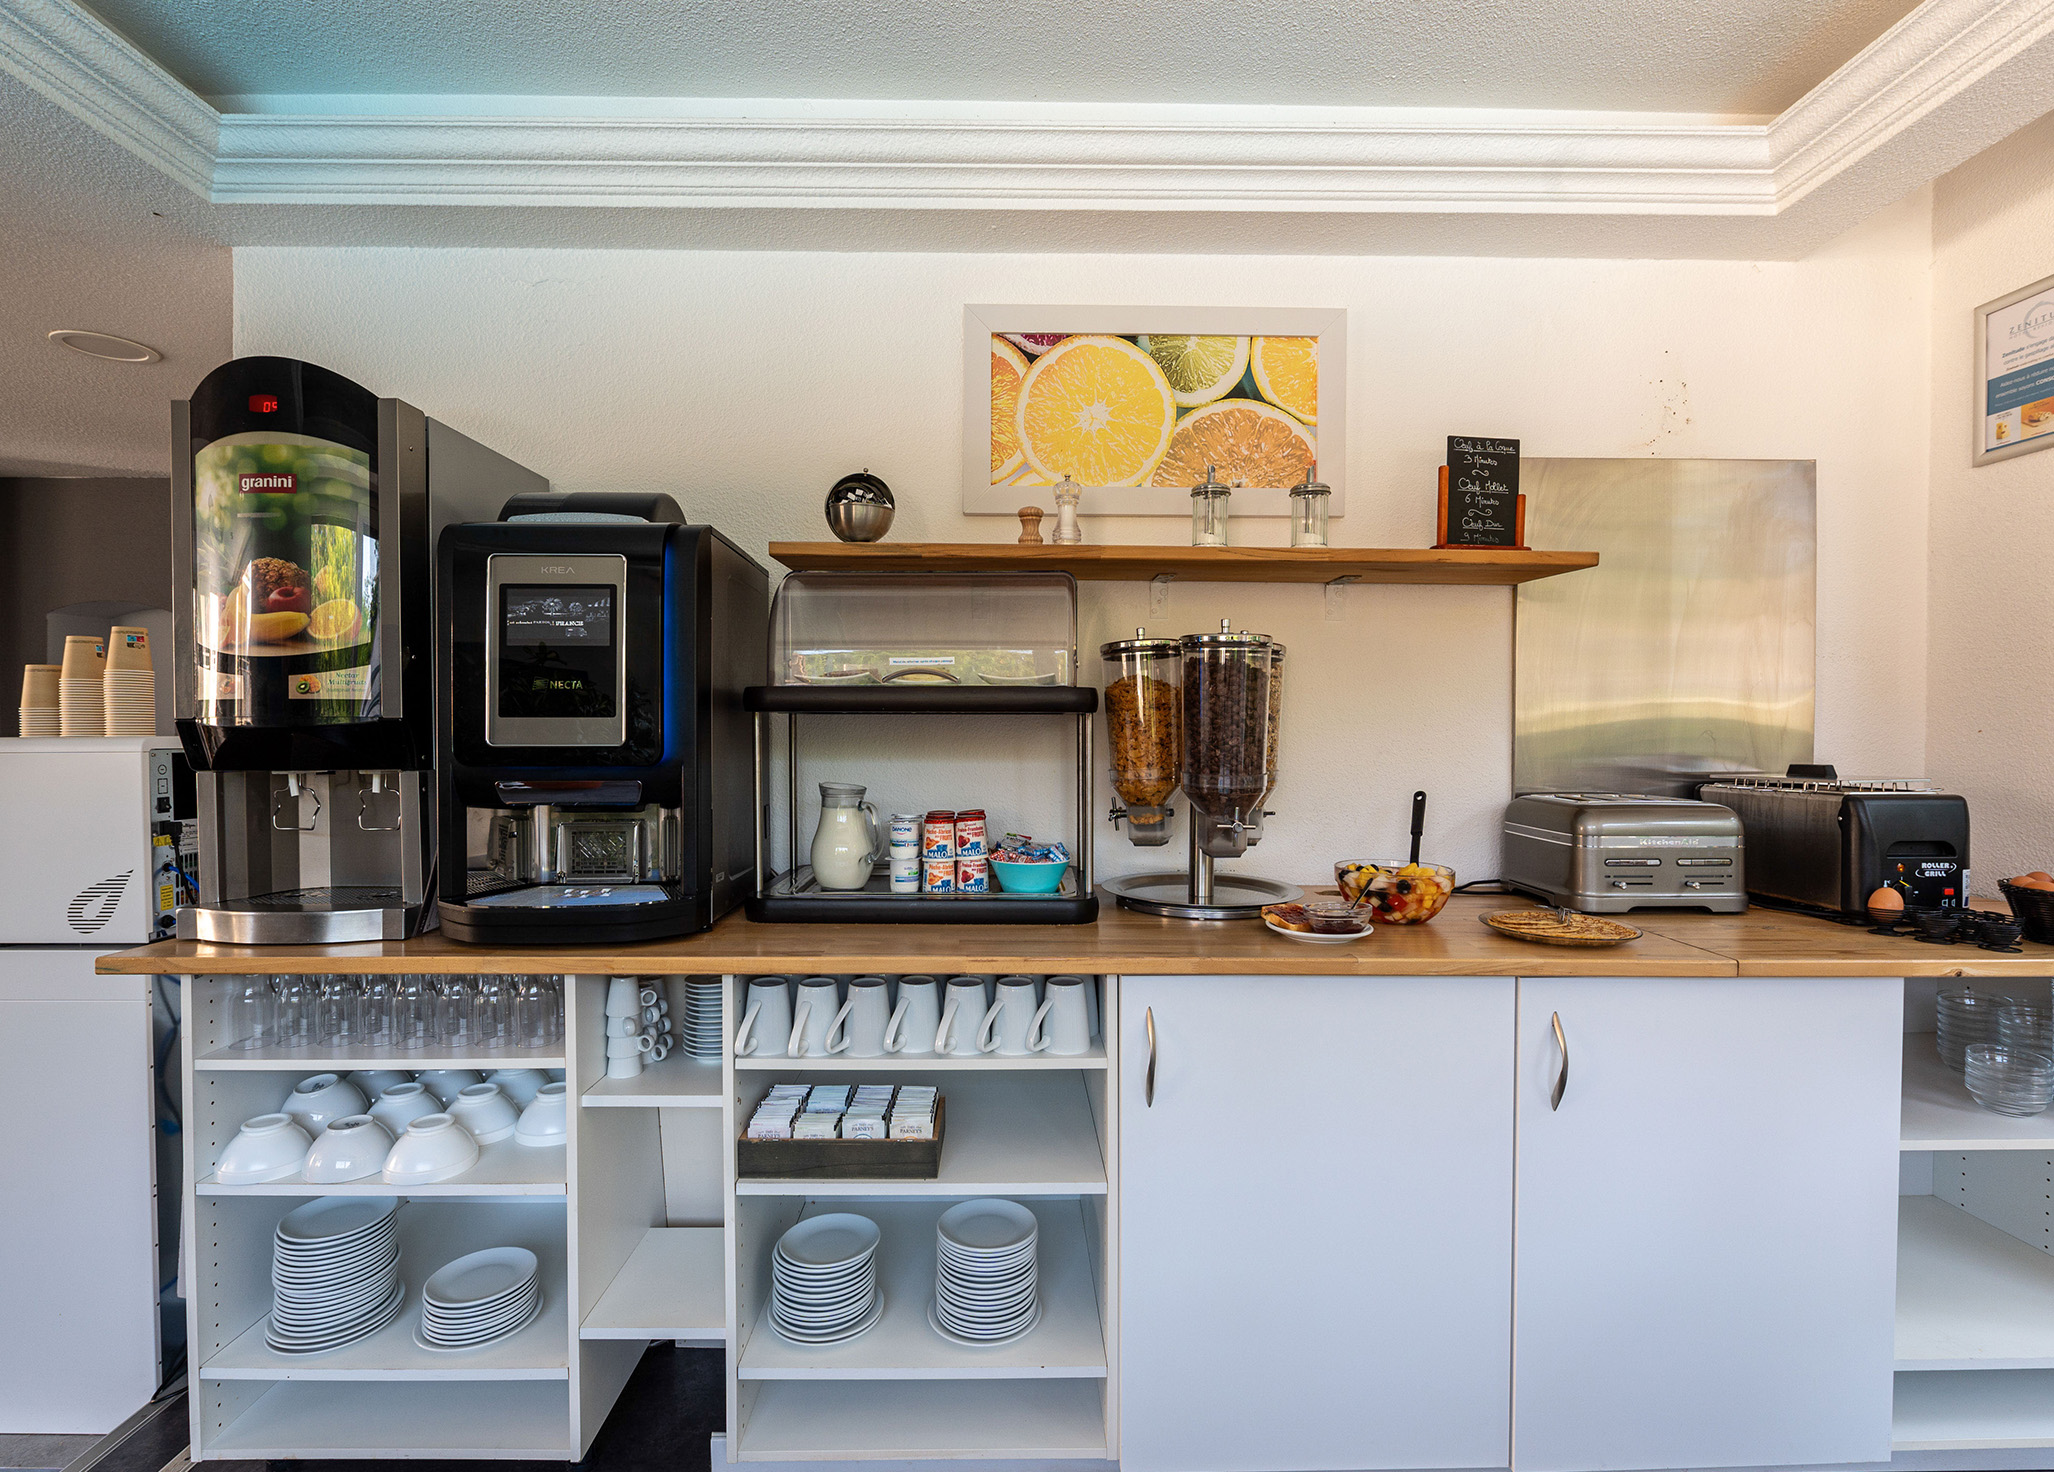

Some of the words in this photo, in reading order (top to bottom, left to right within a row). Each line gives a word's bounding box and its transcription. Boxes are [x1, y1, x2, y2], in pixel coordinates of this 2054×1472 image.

[1463, 454, 1472, 463] 3
[241, 475, 293, 491] granini
[1464, 493, 1471, 503] 6
[541, 566, 575, 574] KREA
[549, 680, 583, 689] NECTA
[1640, 838, 1699, 846] KitchenAid
[928, 850, 947, 858] MALO
[961, 847, 981, 856] MALO
[965, 884, 984, 892] MALO
